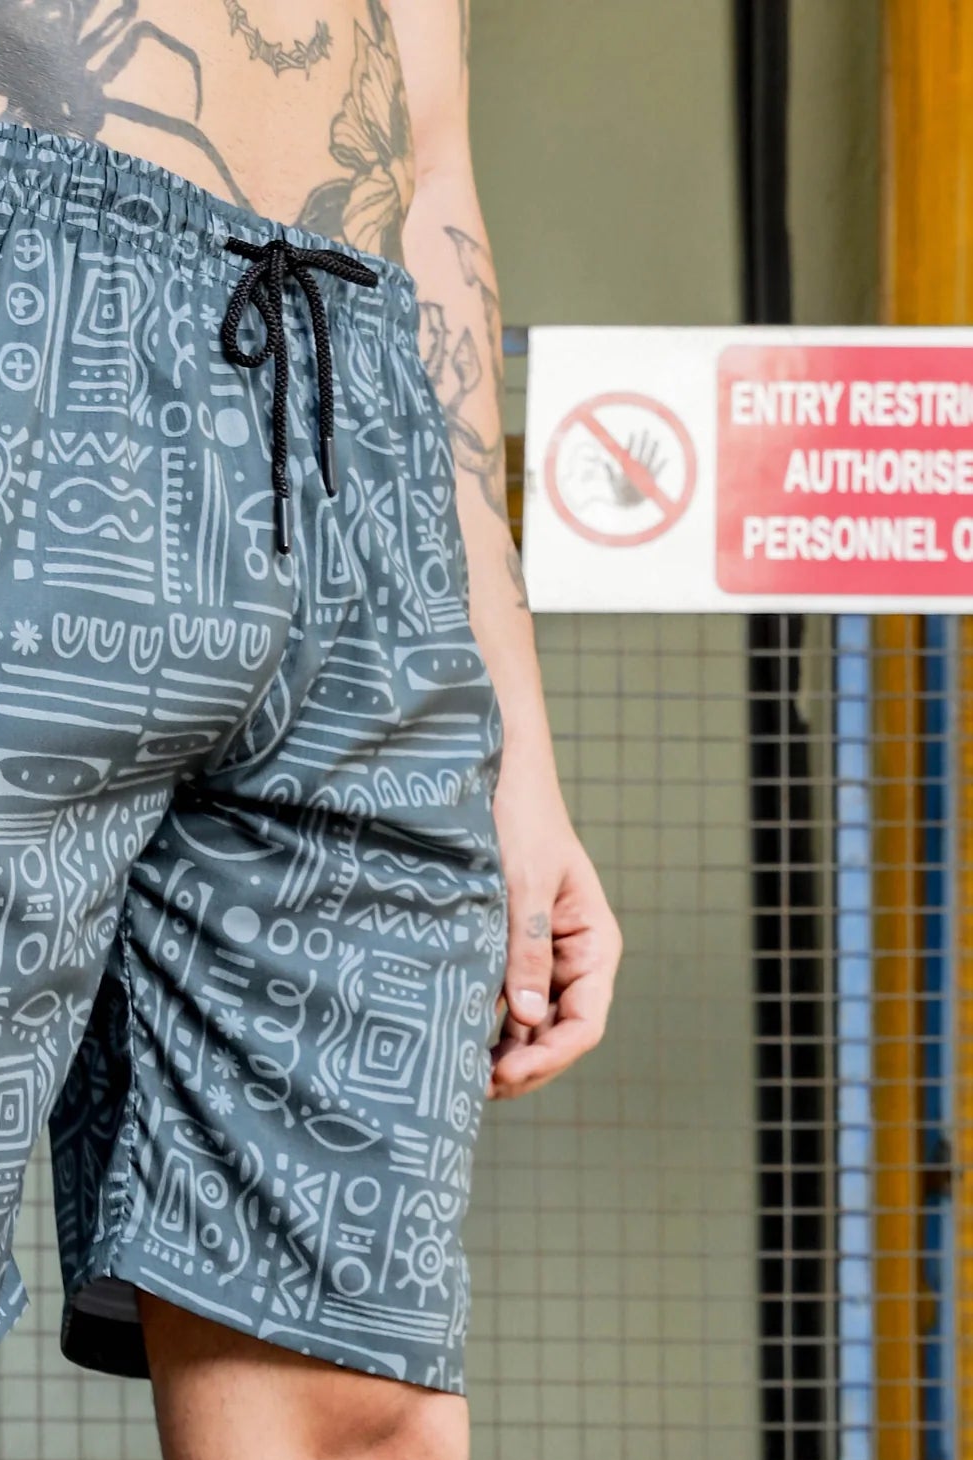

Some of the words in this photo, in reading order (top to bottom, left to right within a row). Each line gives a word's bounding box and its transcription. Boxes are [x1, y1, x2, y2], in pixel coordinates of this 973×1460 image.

[731, 380, 845, 427] ENTRY
[849, 380, 973, 428] RESTRI
[783, 449, 973, 495] AUTHORISE
[743, 515, 947, 561] PERSONNEL
